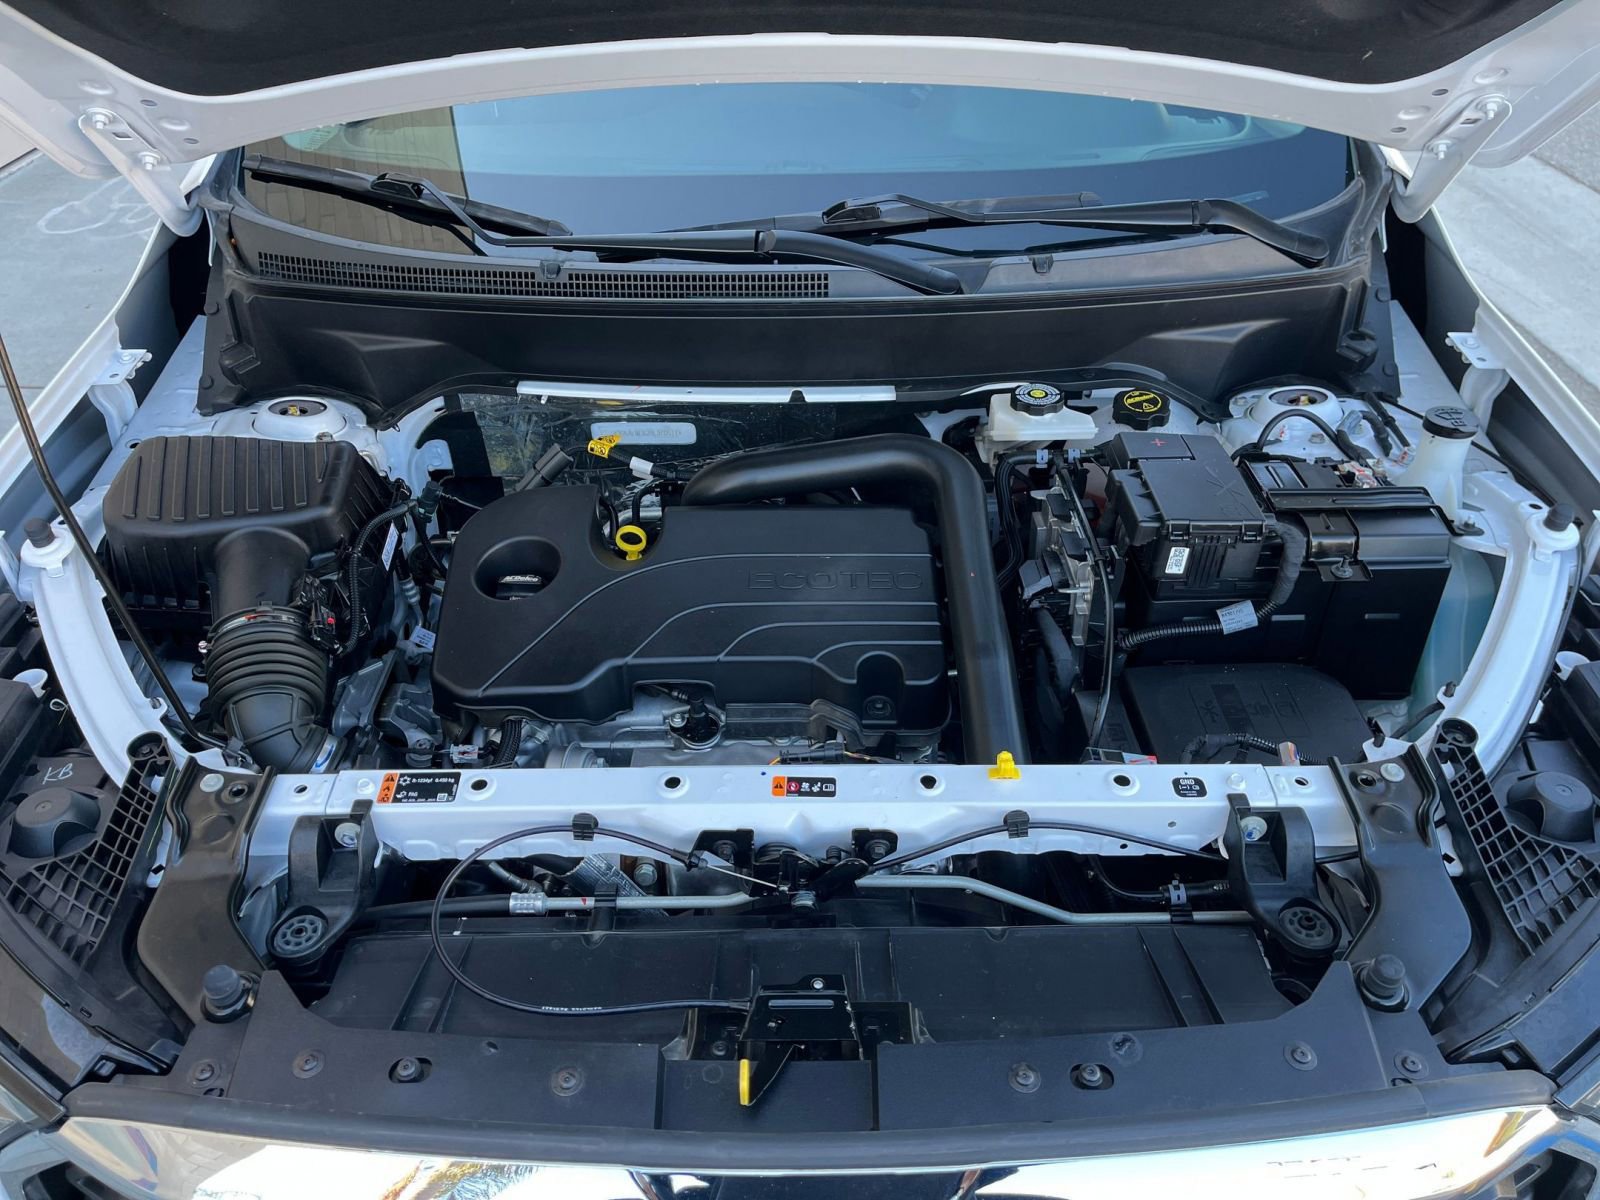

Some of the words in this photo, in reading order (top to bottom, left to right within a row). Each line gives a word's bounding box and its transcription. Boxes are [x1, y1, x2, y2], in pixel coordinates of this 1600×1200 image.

[501, 574, 539, 582] ACDelco
[747, 569, 923, 591] ECOTEC
[41, 762, 74, 785] KB
